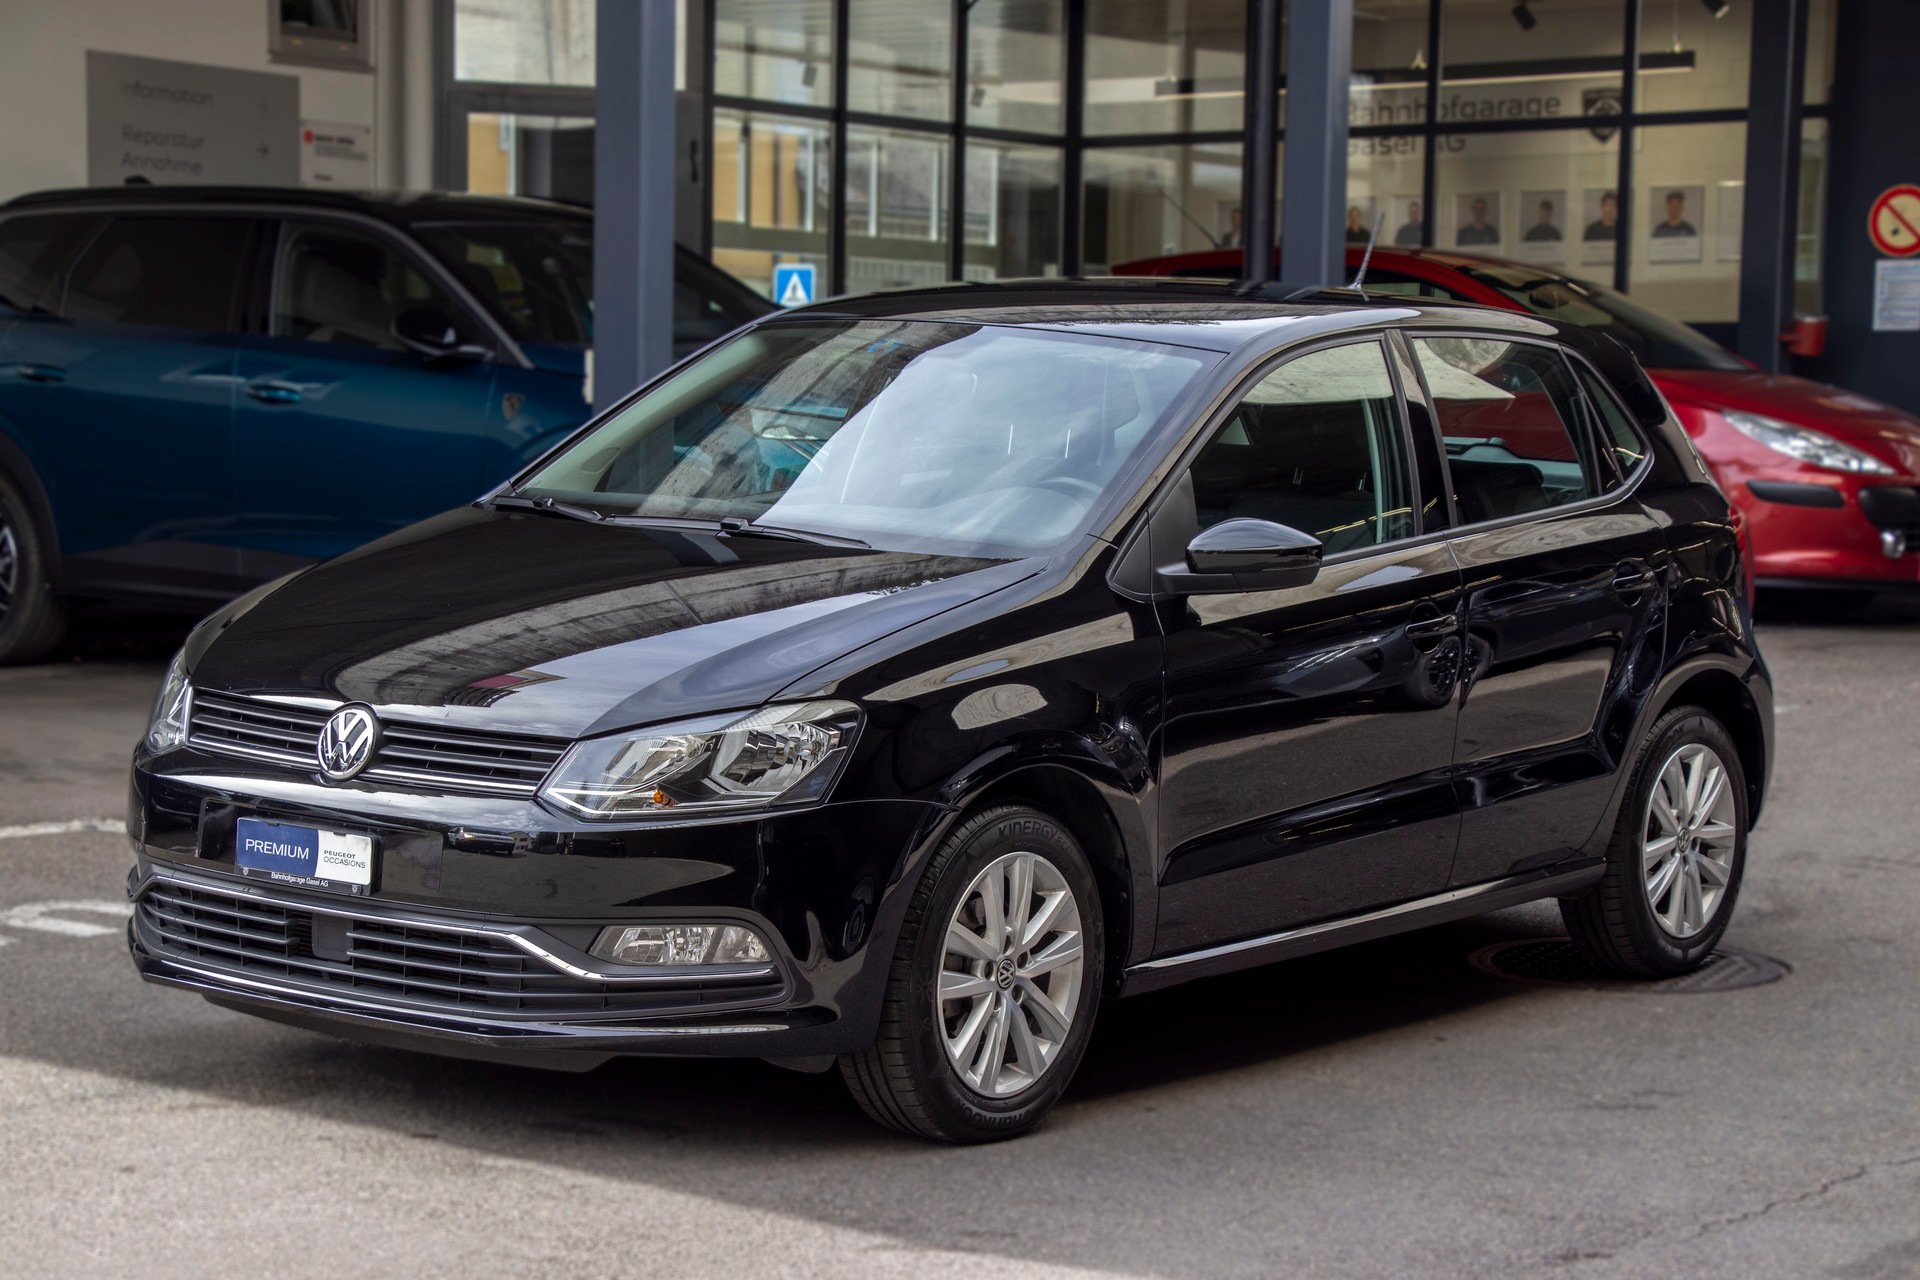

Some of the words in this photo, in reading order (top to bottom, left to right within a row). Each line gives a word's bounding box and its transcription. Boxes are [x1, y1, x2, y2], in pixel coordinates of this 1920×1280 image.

[119, 78, 214, 106] Information
[121, 124, 205, 150] Reparatur
[121, 151, 204, 175] Annahme
[998, 820, 1057, 841] KINERGY
[245, 838, 309, 860] PREMIUM
[323, 849, 356, 859] PEUGEOT
[323, 856, 366, 868] OCCASIONS
[271, 871, 305, 884] Bahnhofgarage
[306, 877, 320, 886] Gasel
[320, 879, 329, 887] AG
